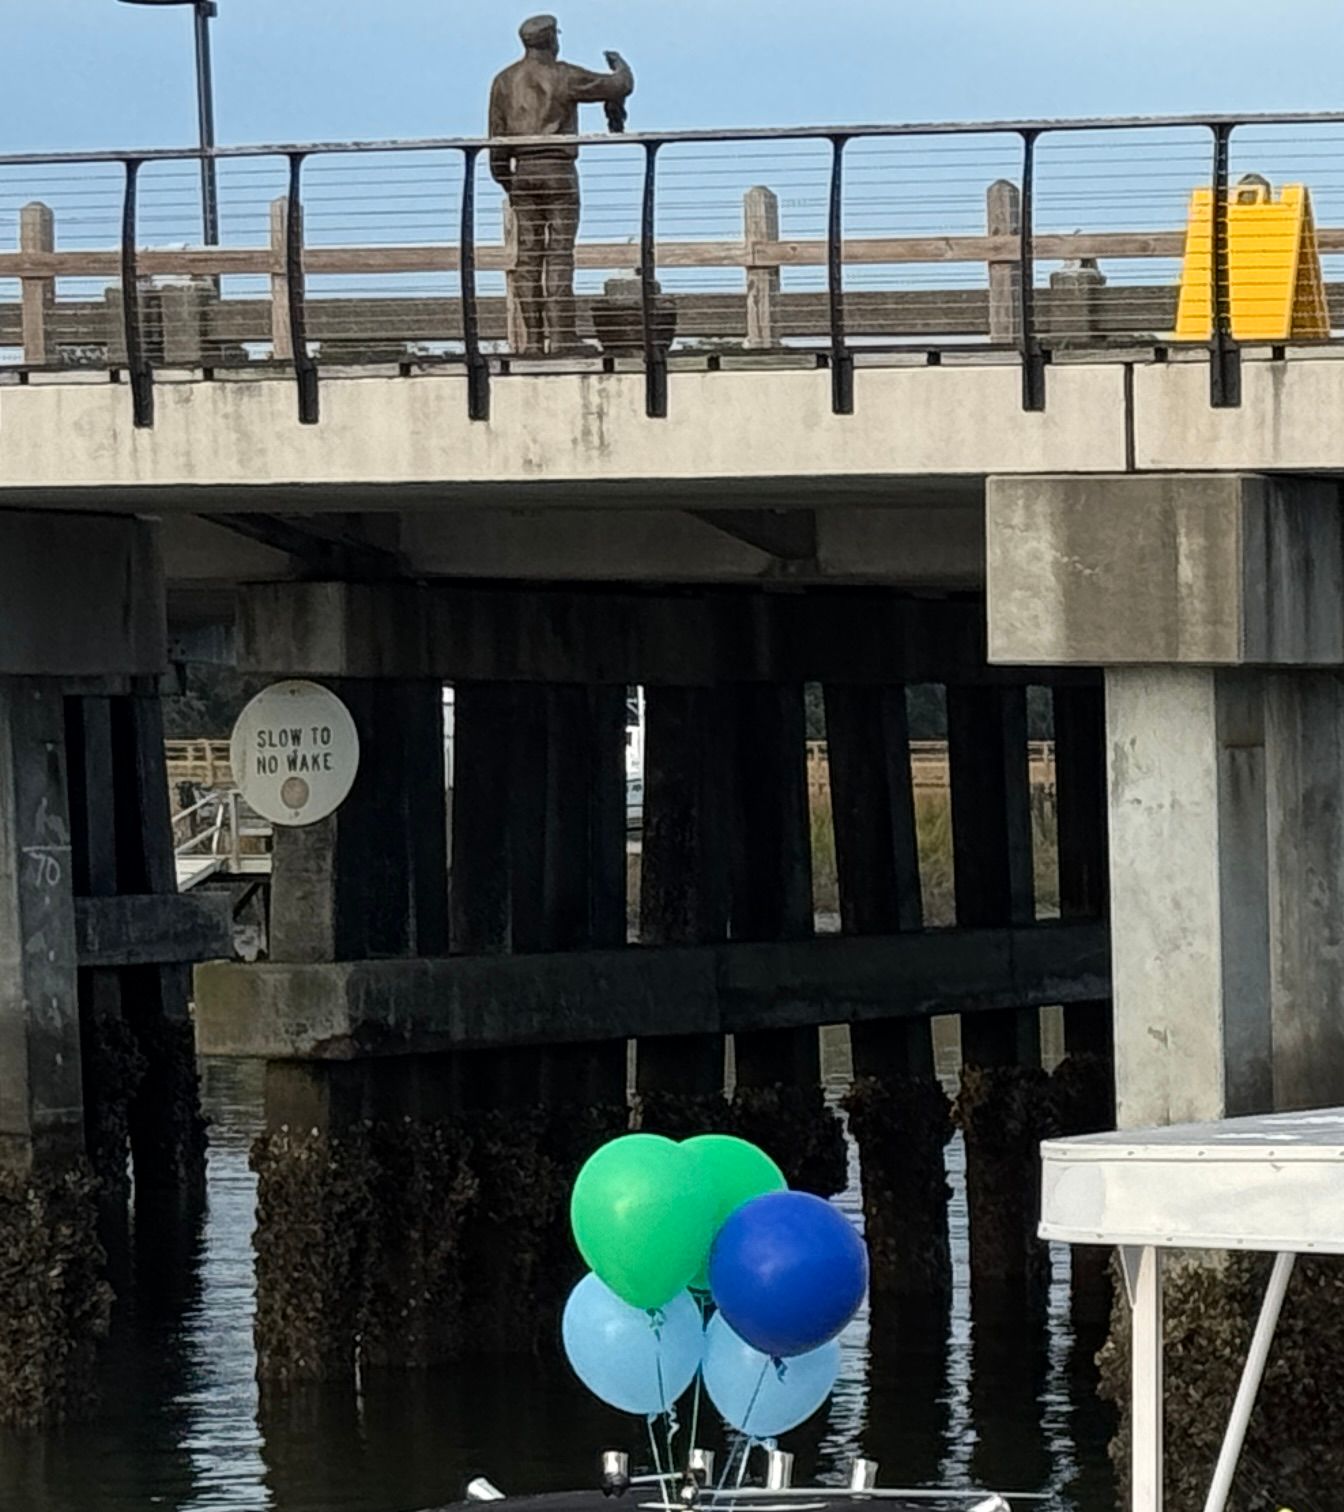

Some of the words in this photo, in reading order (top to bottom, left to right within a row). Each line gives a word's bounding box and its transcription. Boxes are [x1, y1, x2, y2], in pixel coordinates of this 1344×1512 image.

[256, 728, 303, 749] SLOW
[311, 726, 332, 746] TO
[256, 755, 279, 775] NO
[286, 752, 333, 773] WAKE
